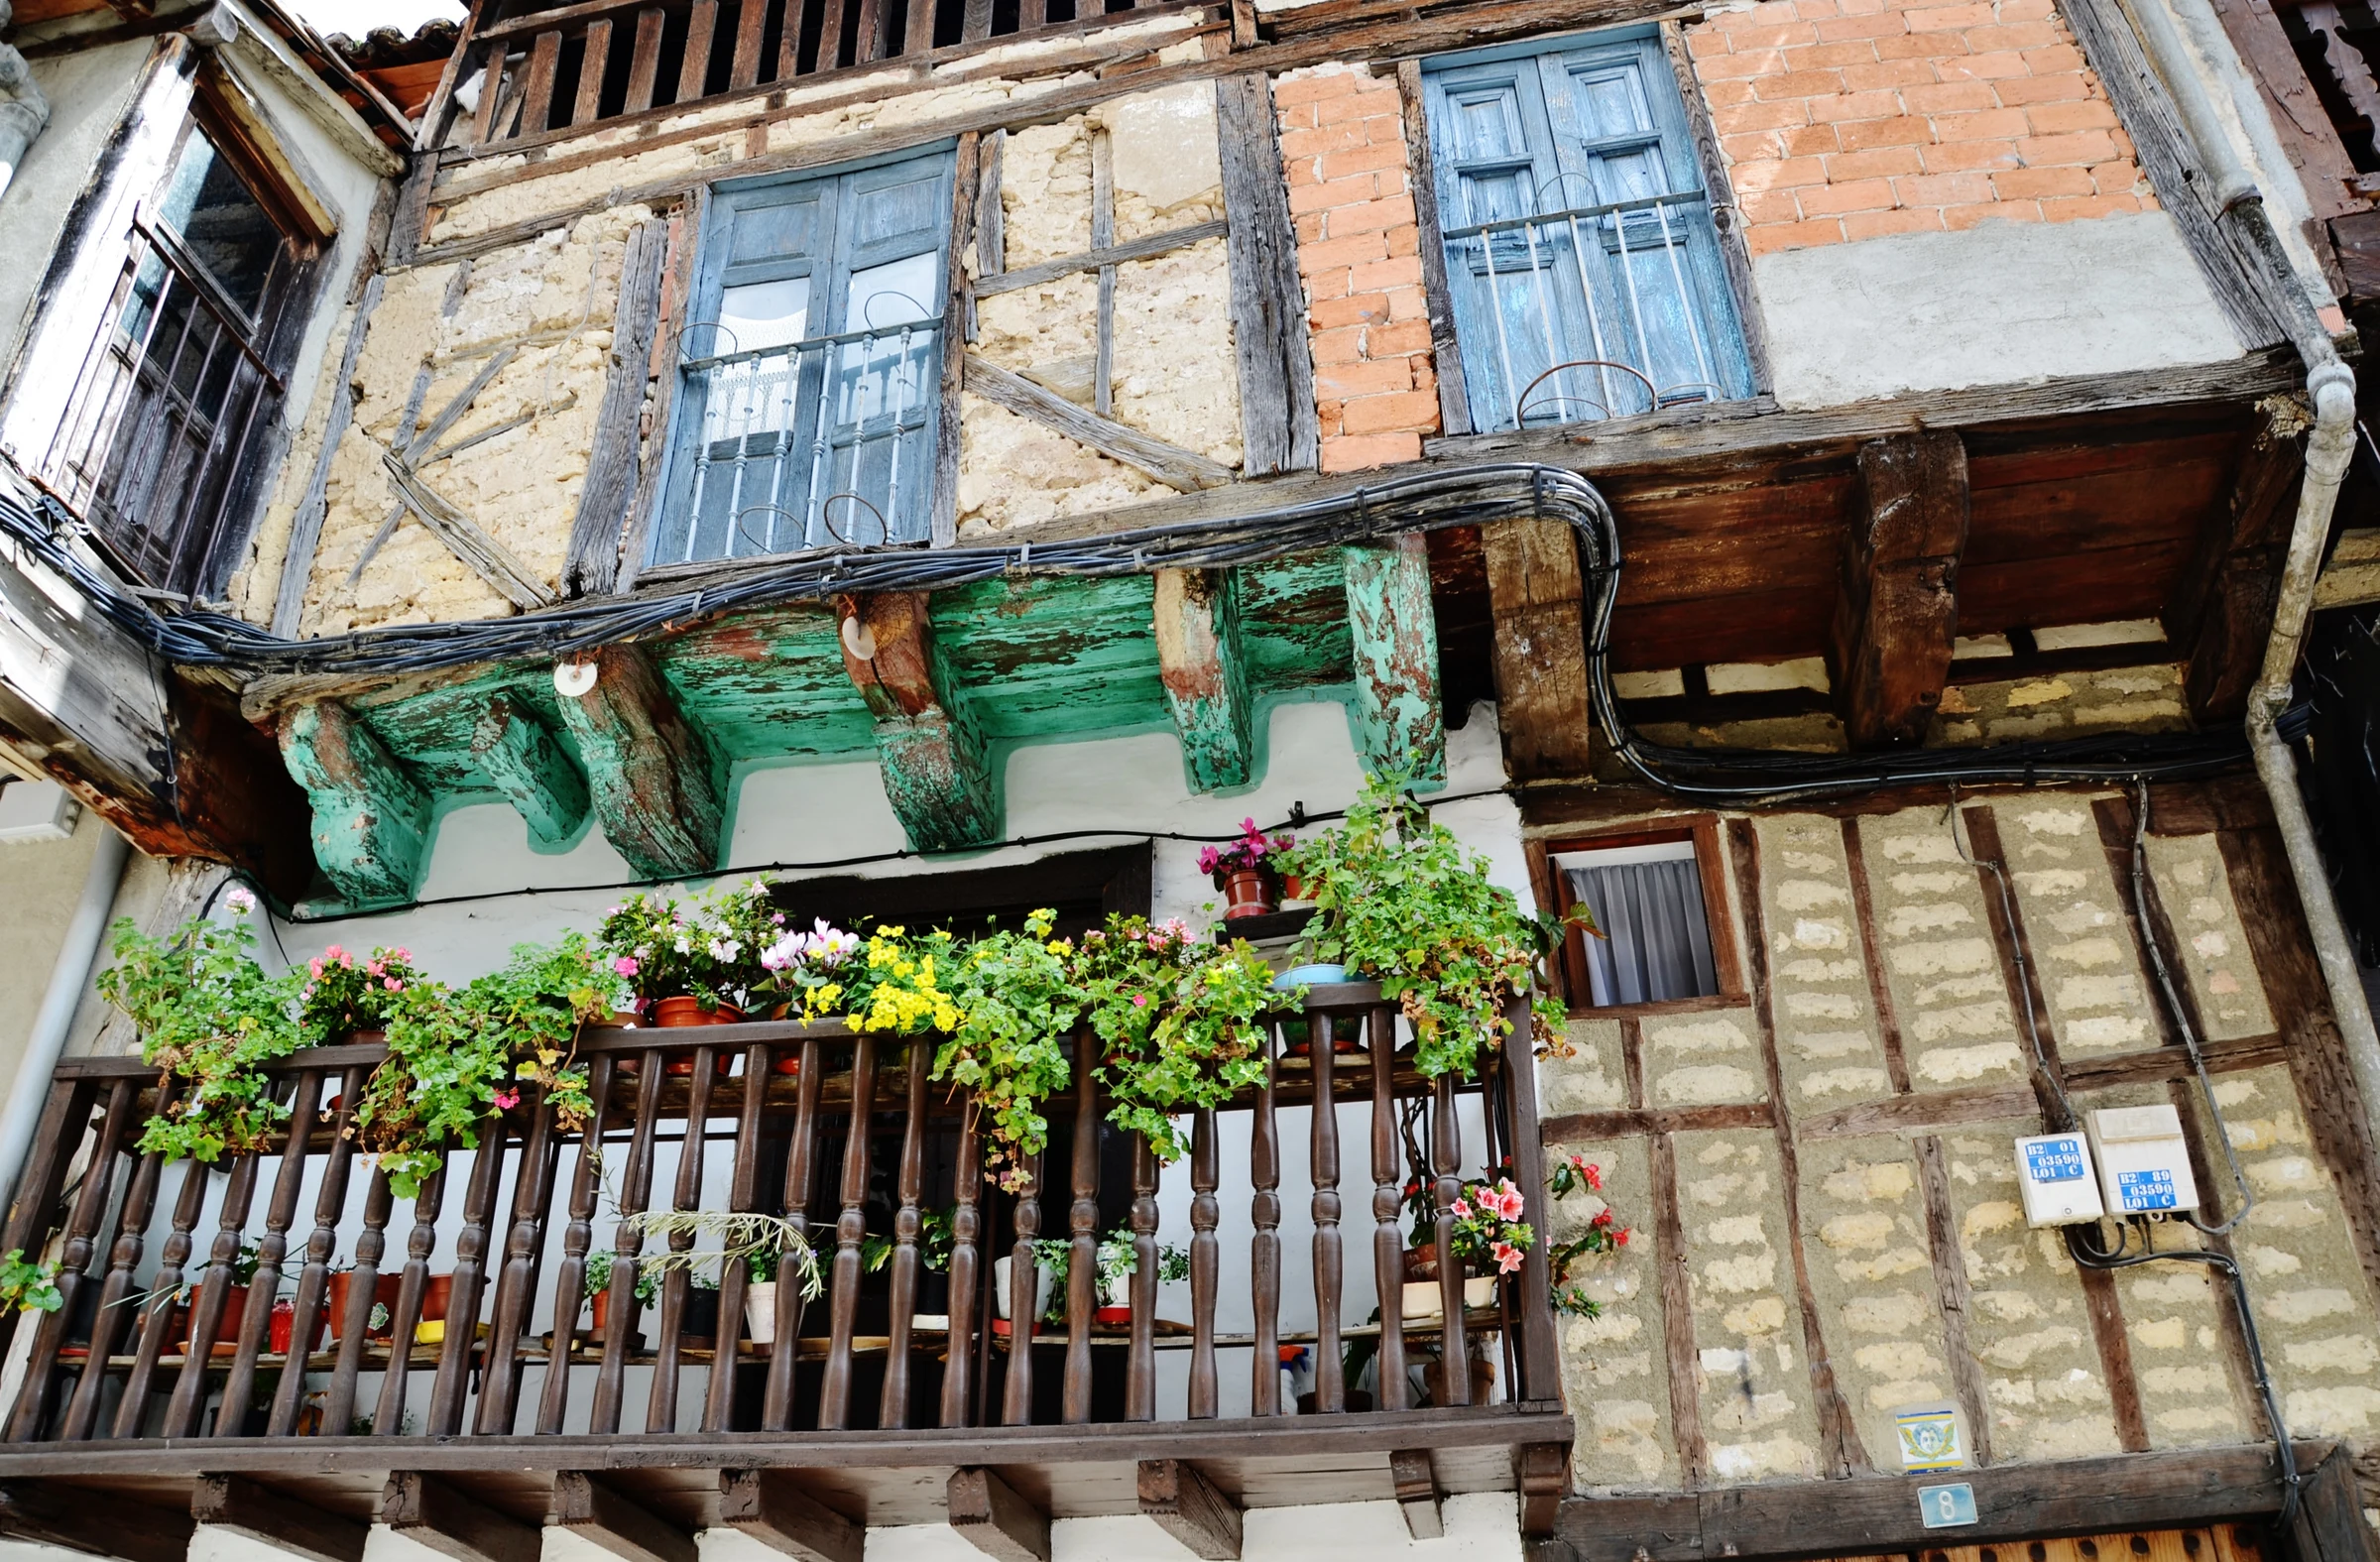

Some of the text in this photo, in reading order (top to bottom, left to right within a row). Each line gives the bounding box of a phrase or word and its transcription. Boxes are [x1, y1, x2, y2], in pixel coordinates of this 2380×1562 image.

[2026, 1141, 2076, 1156] B2 01
[2037, 1153, 2080, 1167] 03590
[2069, 1164, 2079, 1175] C
[2120, 1170, 2171, 1185] B2 89
[2130, 1183, 2173, 1196] 03590
[2161, 1195, 2172, 1206] C
[1938, 1491, 1956, 1520] 8
